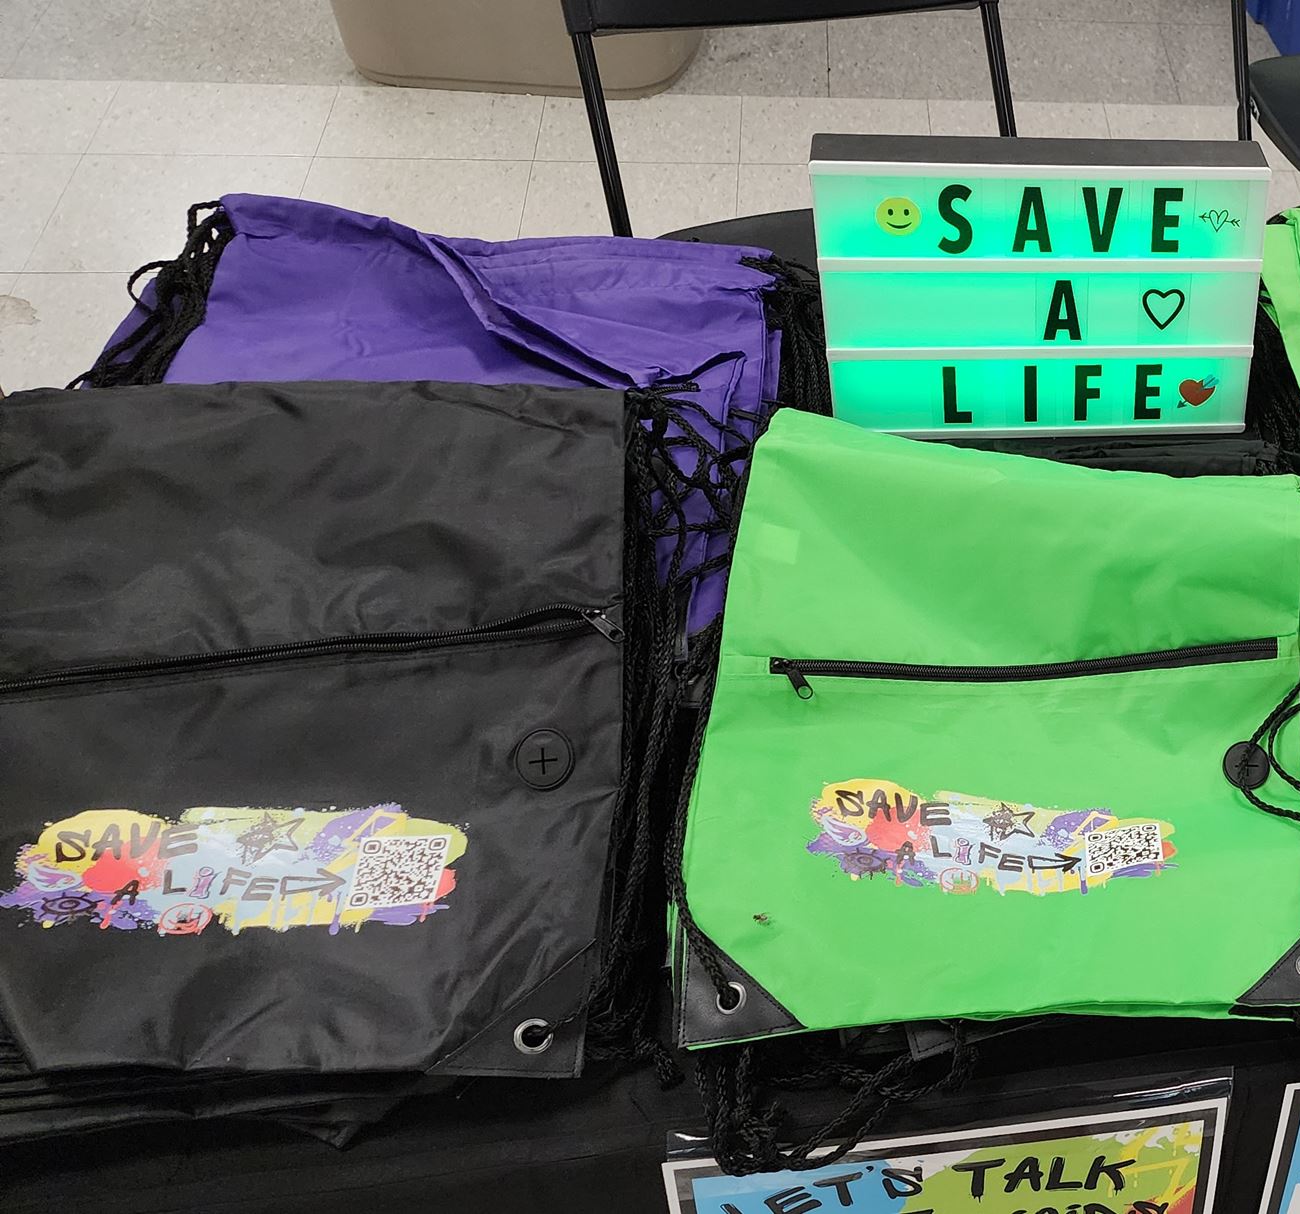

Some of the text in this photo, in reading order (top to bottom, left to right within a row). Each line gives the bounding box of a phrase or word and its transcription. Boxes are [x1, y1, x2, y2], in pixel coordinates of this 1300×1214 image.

[938, 184, 1184, 254] SAVE
[1043, 280, 1082, 341] A
[942, 364, 1163, 424] LIFE
[835, 789, 952, 826] SAVE
[55, 823, 198, 863] SAVE
[895, 841, 917, 865] A
[112, 880, 140, 905] A
[952, 1155, 1136, 1203] TALK
